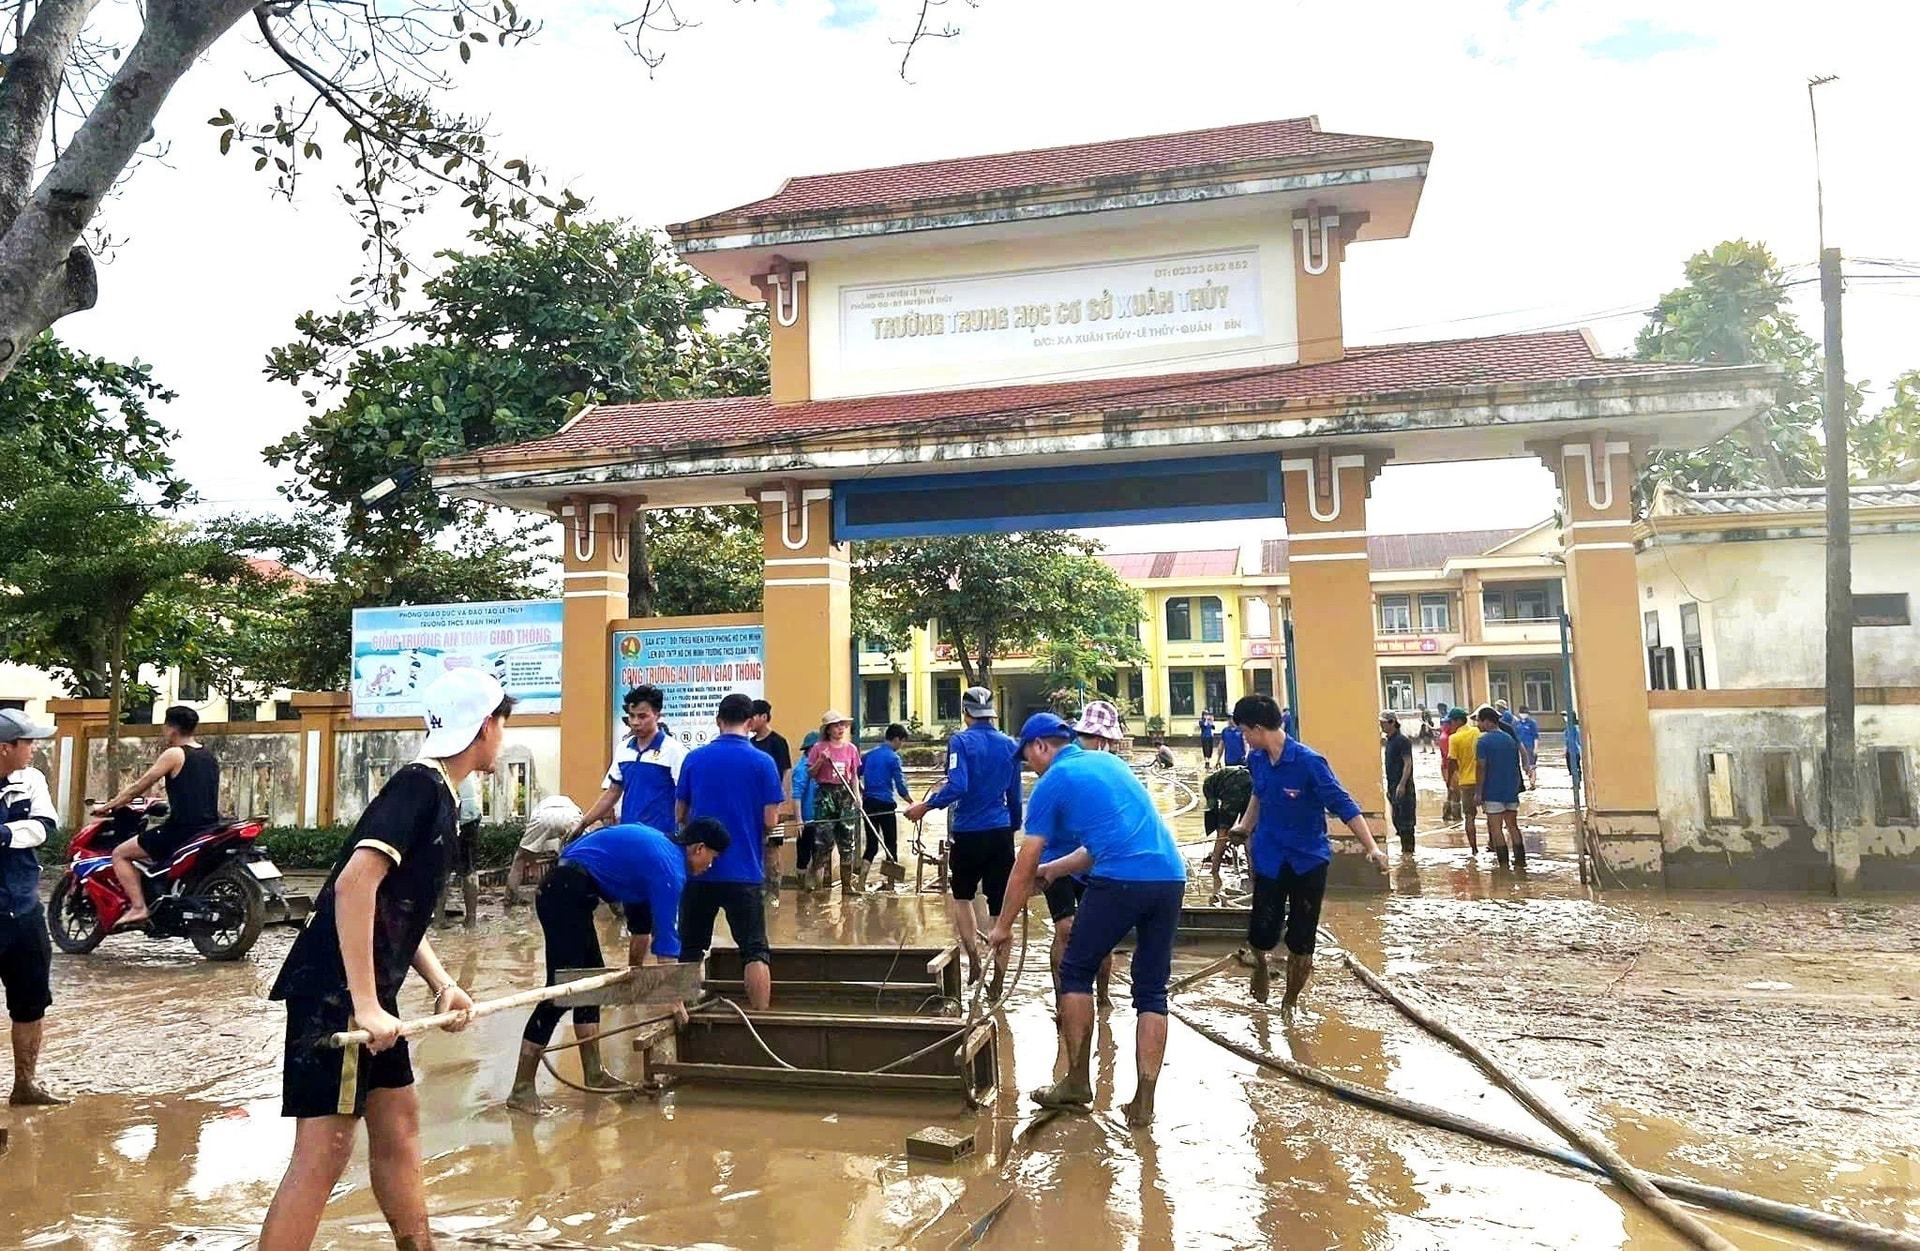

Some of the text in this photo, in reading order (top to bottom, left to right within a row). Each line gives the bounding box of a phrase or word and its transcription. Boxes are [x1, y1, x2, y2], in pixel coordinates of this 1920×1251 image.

[872, 279, 1230, 340] TRƯỜNG TRUNG HỌC CƠ SỞ XUÂN THỦY
[1075, 331, 1104, 344] XUÂN
[489, 629, 514, 646] GIAO
[621, 660, 762, 685] CỔNG TRƯỜNG AN TOÀN GIAO THÔNG
